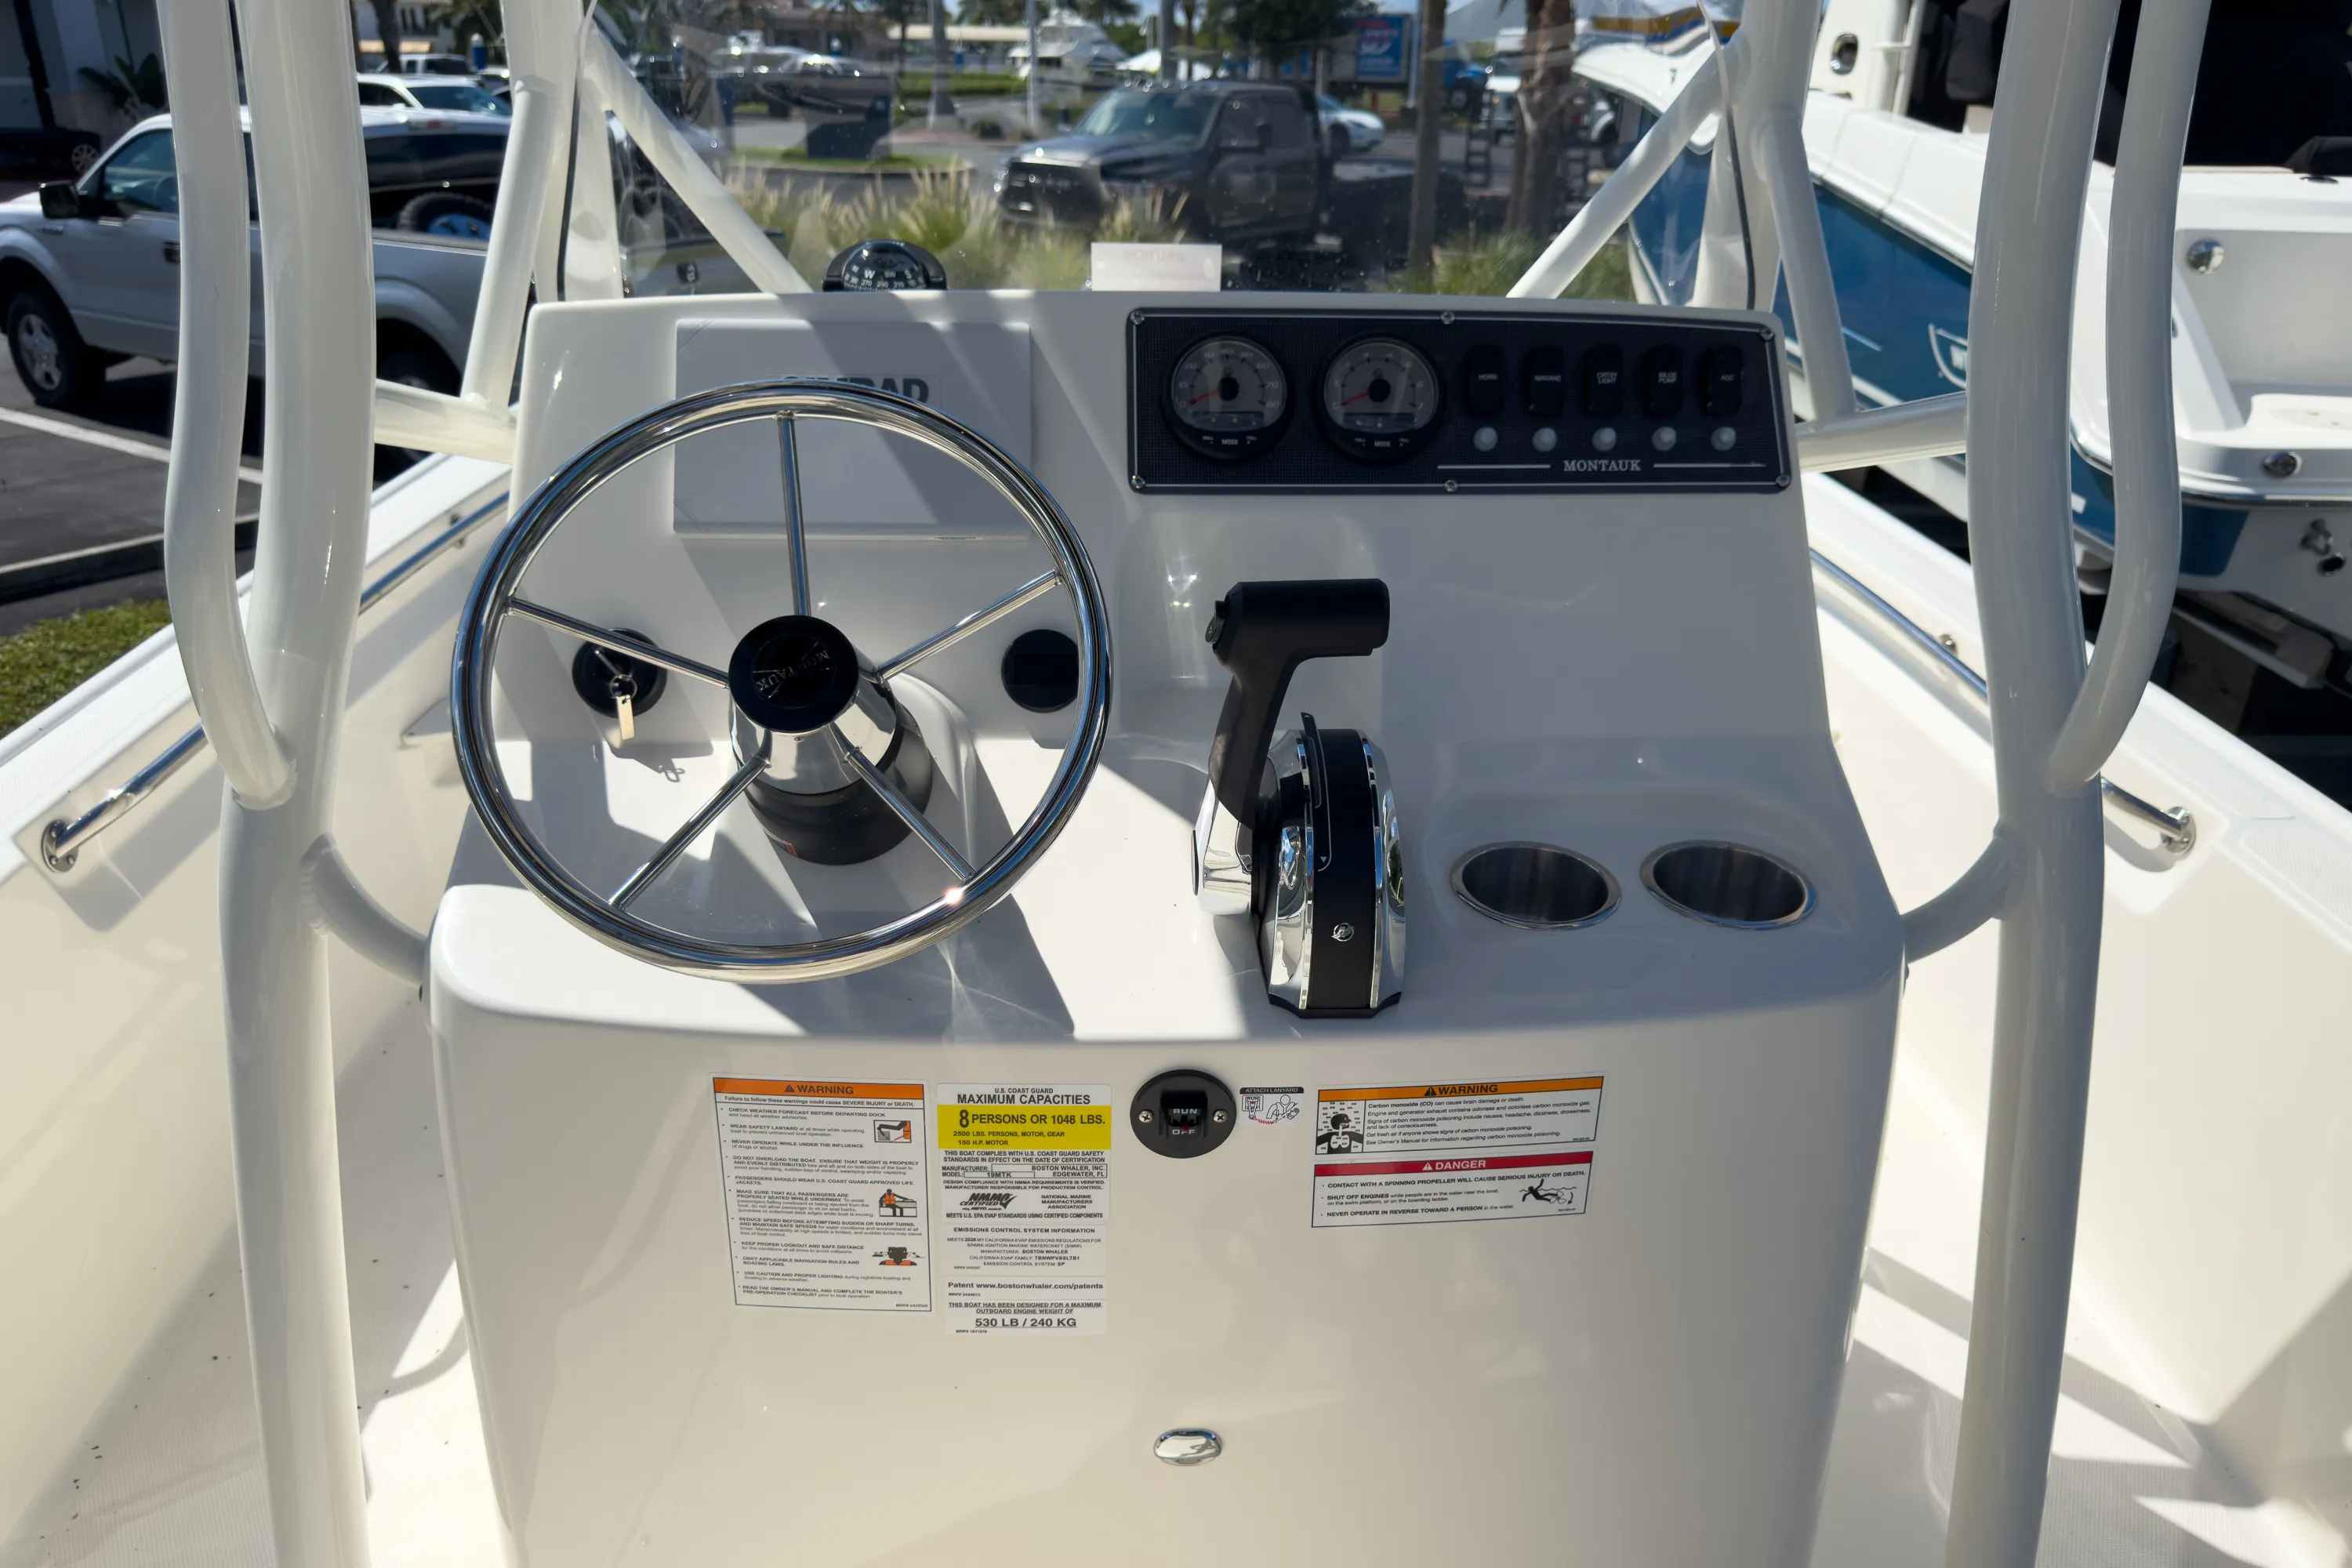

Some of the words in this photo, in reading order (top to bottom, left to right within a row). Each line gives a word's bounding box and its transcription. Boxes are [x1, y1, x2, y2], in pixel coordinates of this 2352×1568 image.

[865, 269, 875, 279] W
[1563, 459, 1641, 471] MONTAUK
[797, 1085, 854, 1094] WARNING
[1438, 1084, 1497, 1094] WARNING
[957, 1094, 1015, 1104] MAXIMUM
[1019, 1094, 1091, 1105] CAPACITIES
[960, 1109, 969, 1128] 8
[972, 1114, 1026, 1124] PERSONS
[1030, 1114, 1047, 1124] OR
[1051, 1114, 1076, 1124] 1048
[1080, 1114, 1105, 1124] LBS.
[1436, 1160, 1486, 1170] DANGER
[1030, 1318, 1053, 1327] 240
[1057, 1318, 1076, 1327] KG
